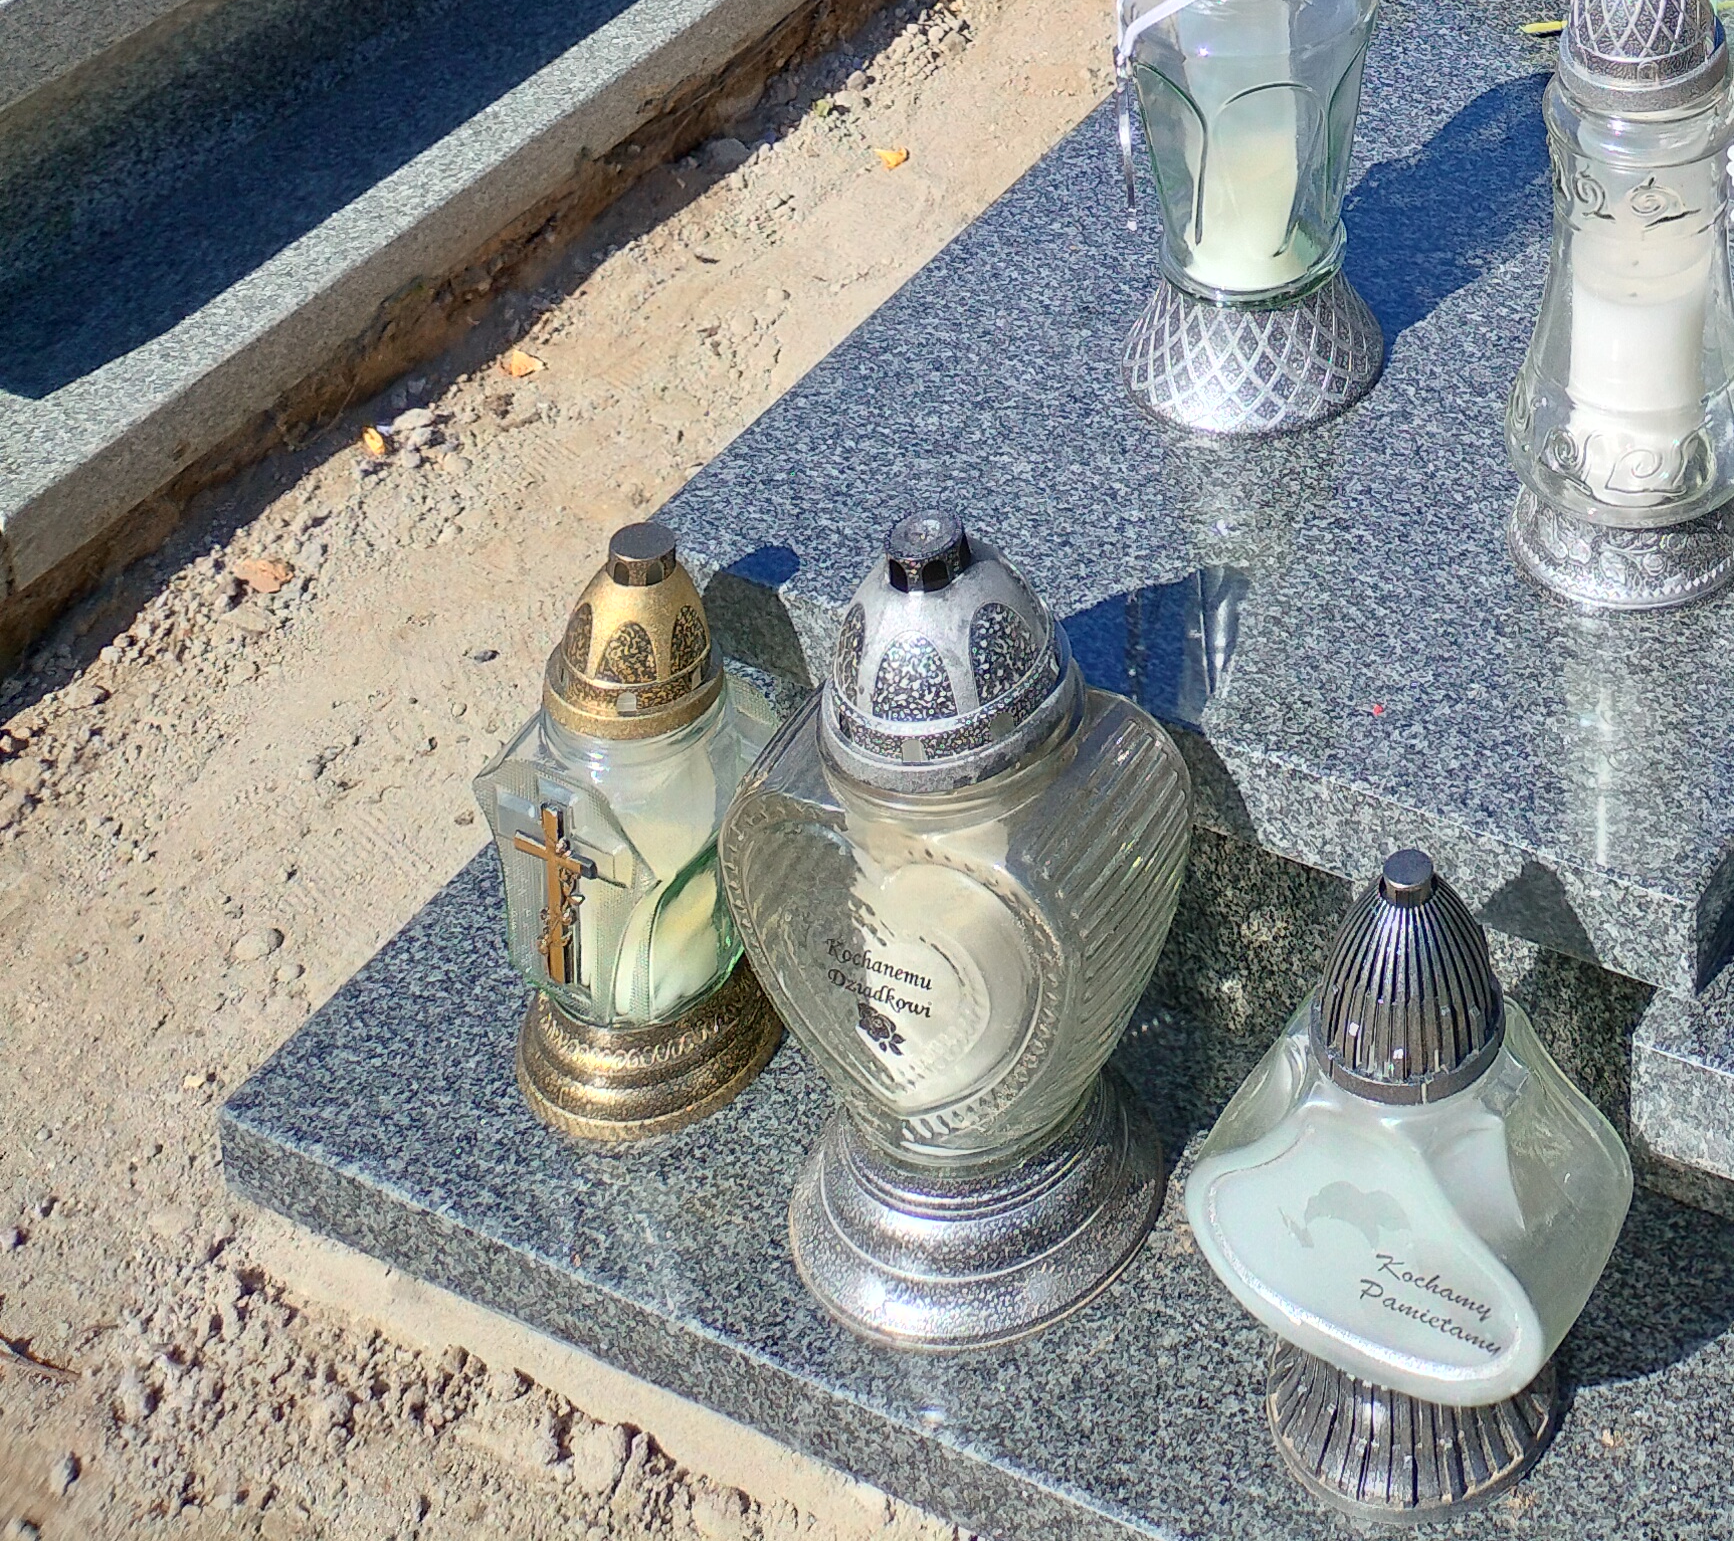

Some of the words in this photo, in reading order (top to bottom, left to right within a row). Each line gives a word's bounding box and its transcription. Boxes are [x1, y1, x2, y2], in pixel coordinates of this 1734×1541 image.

[825, 937, 933, 991] Kochanemu
[827, 968, 933, 1018] Dziadkowi
[1375, 1253, 1492, 1324] Kochamy
